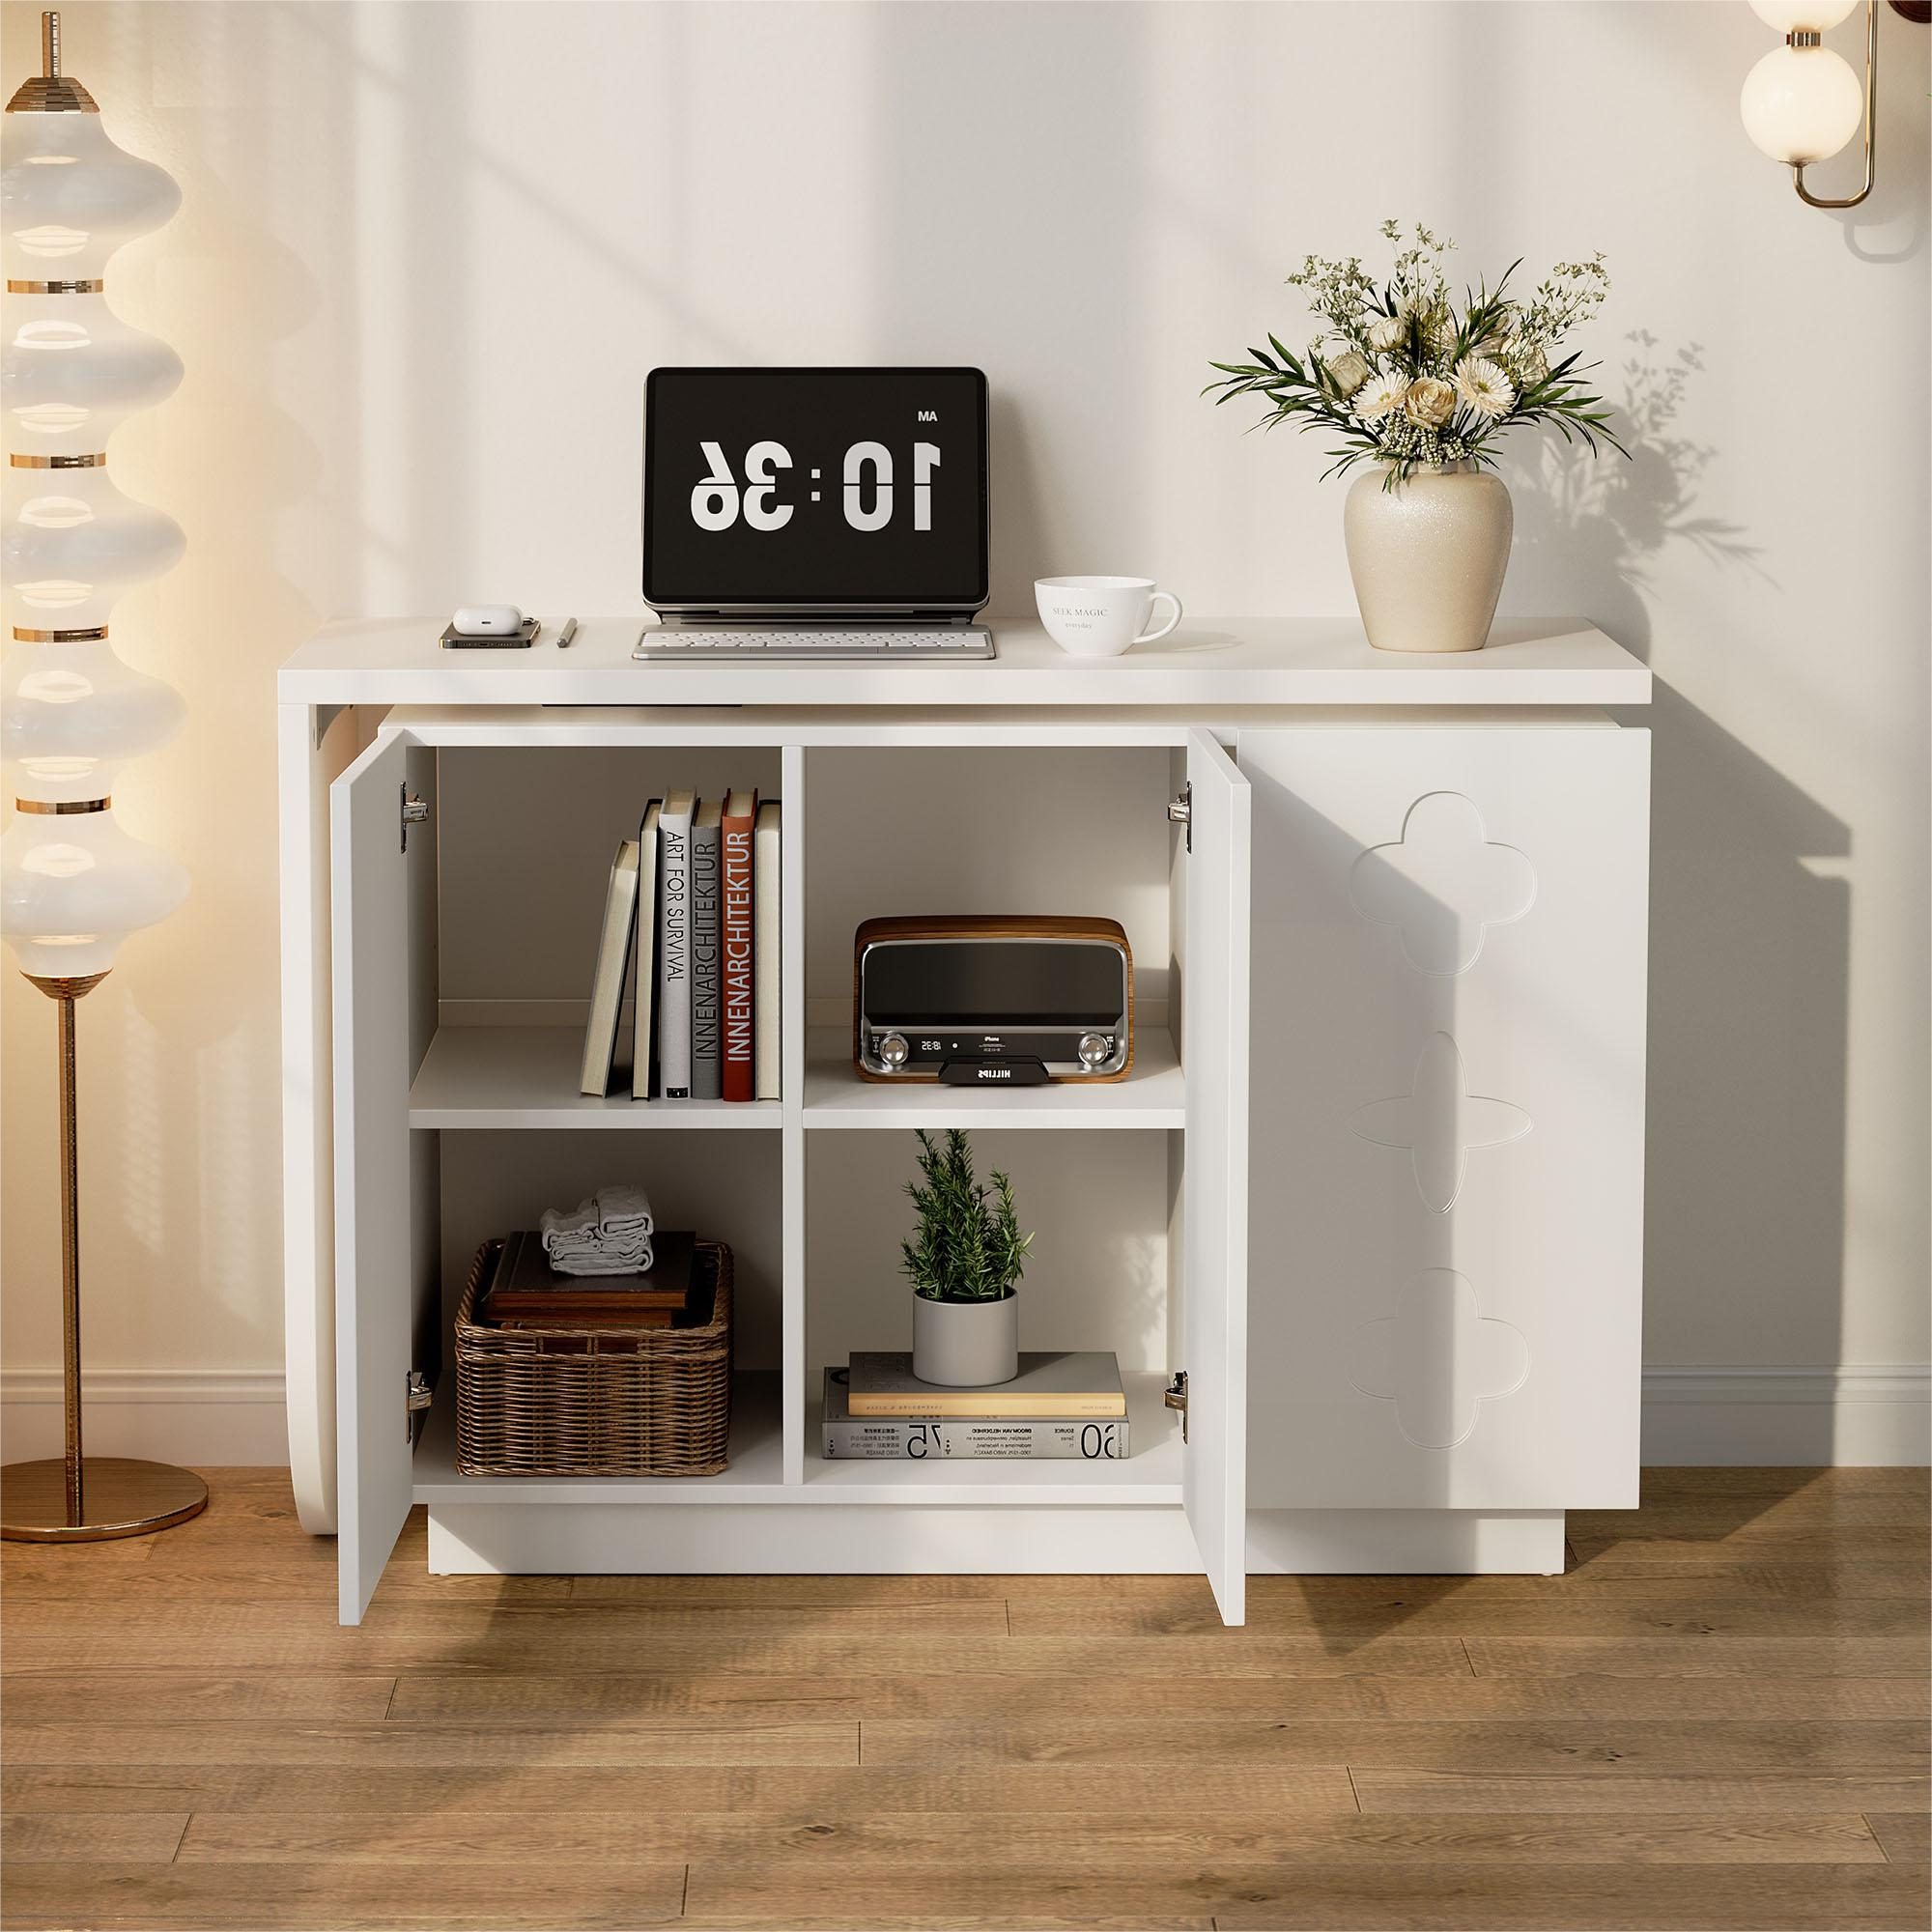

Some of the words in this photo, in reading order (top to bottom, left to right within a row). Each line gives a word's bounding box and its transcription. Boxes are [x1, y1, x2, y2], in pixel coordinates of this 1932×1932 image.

[1052, 608, 1073, 616] SEEK
[1075, 609, 1108, 617] MAGIC
[667, 831, 685, 862] ART
[667, 869, 685, 902] FOR
[667, 908, 685, 982] SURVIVAL
[695, 842, 717, 1060] INNENARCHITEKTUR
[726, 831, 751, 1062] INNENARCHITEKTUR
